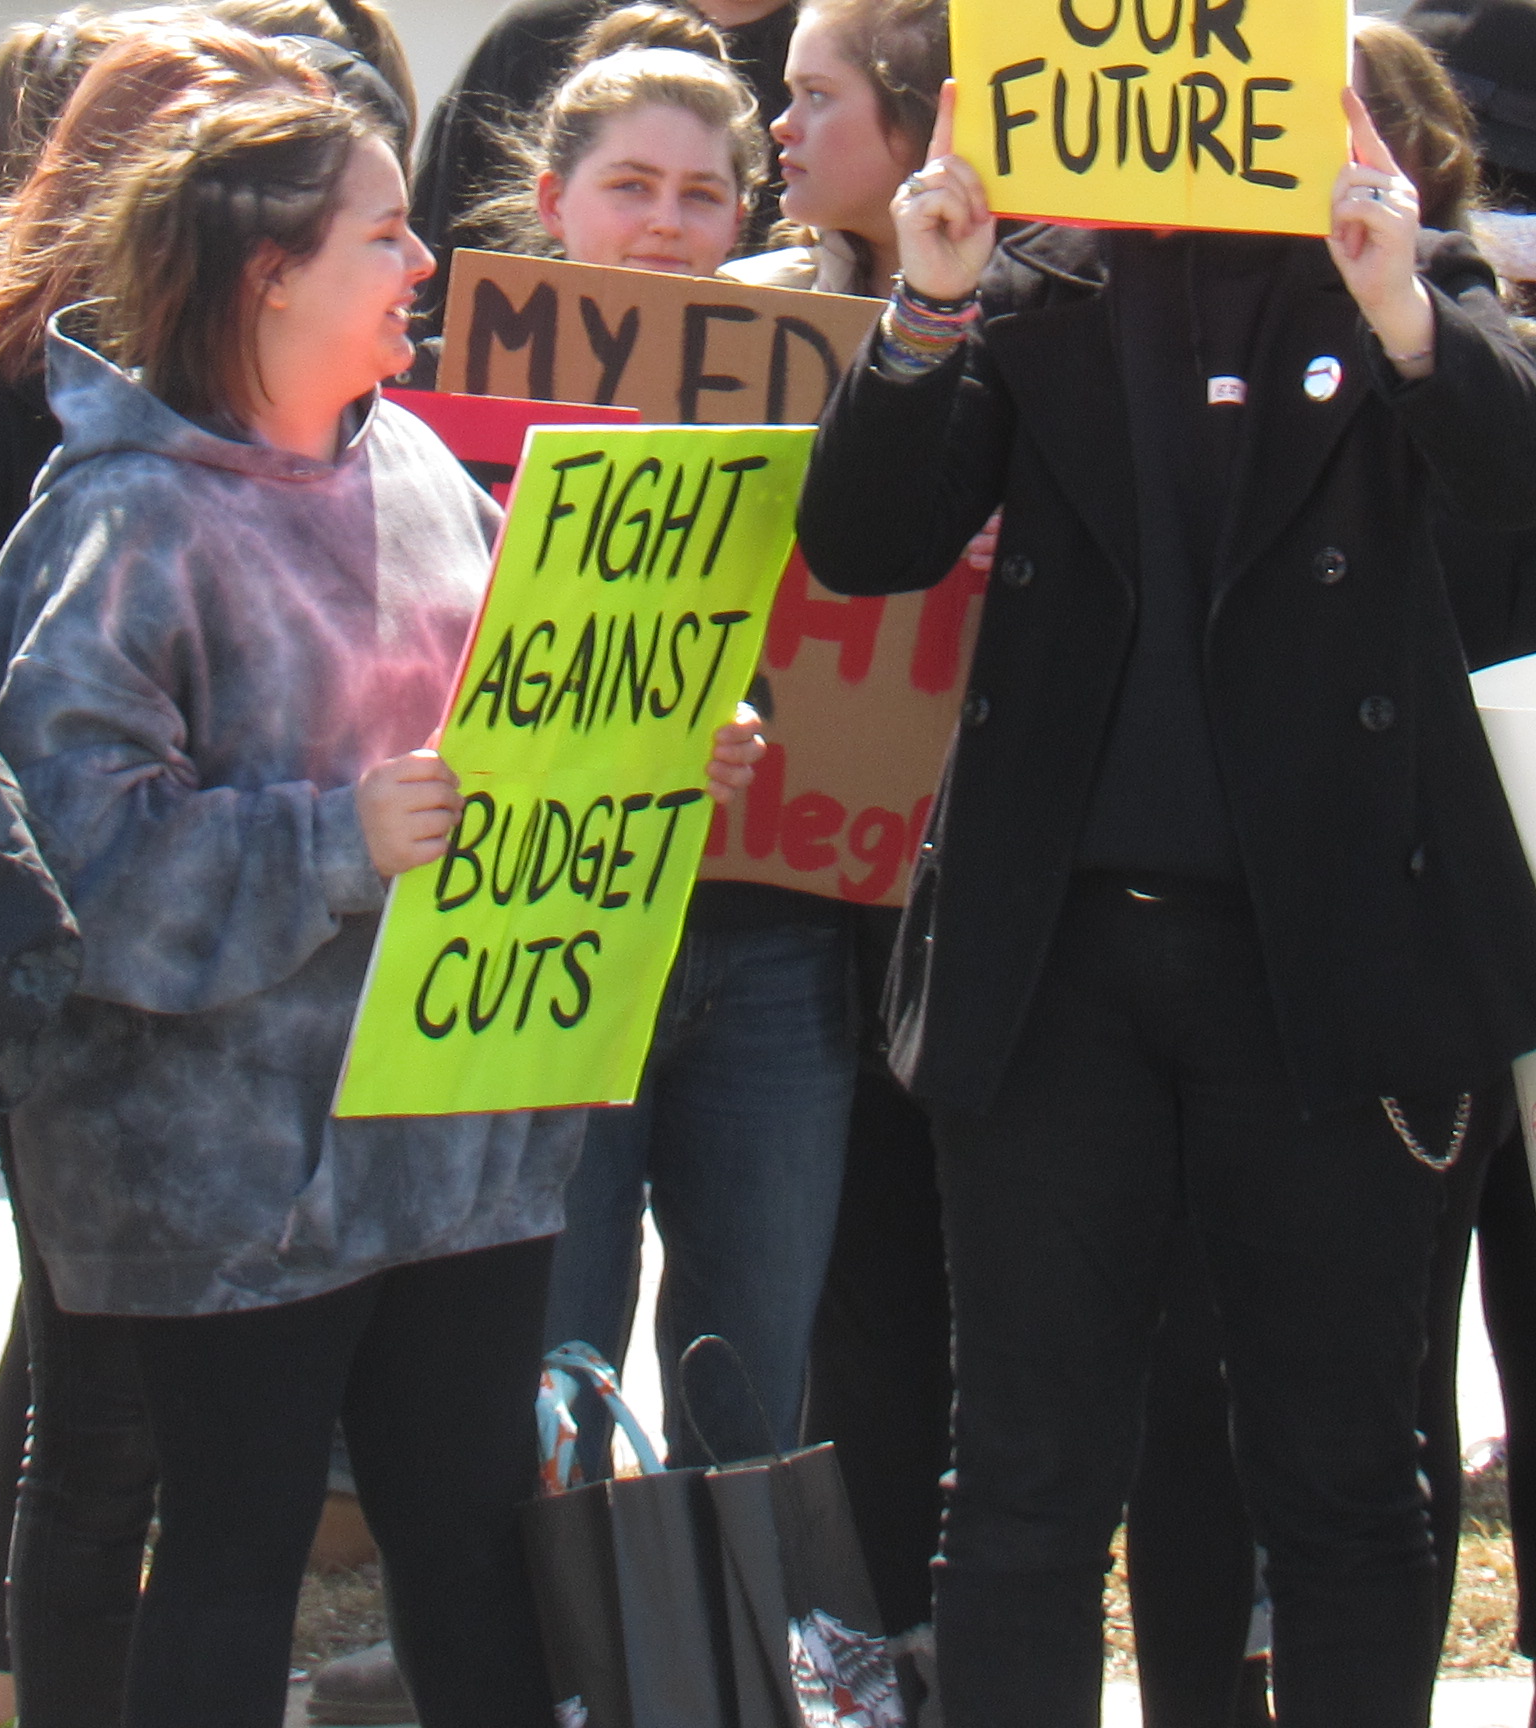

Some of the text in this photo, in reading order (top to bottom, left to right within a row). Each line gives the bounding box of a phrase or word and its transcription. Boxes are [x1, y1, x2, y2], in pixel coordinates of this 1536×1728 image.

[988, 56, 1300, 190] FUTURE
[466, 278, 640, 406] MY
[535, 450, 769, 583] FIGHT
[458, 609, 752, 735] AGAINST
[435, 787, 704, 913] BUDGET
[414, 929, 602, 1040] CUTS
